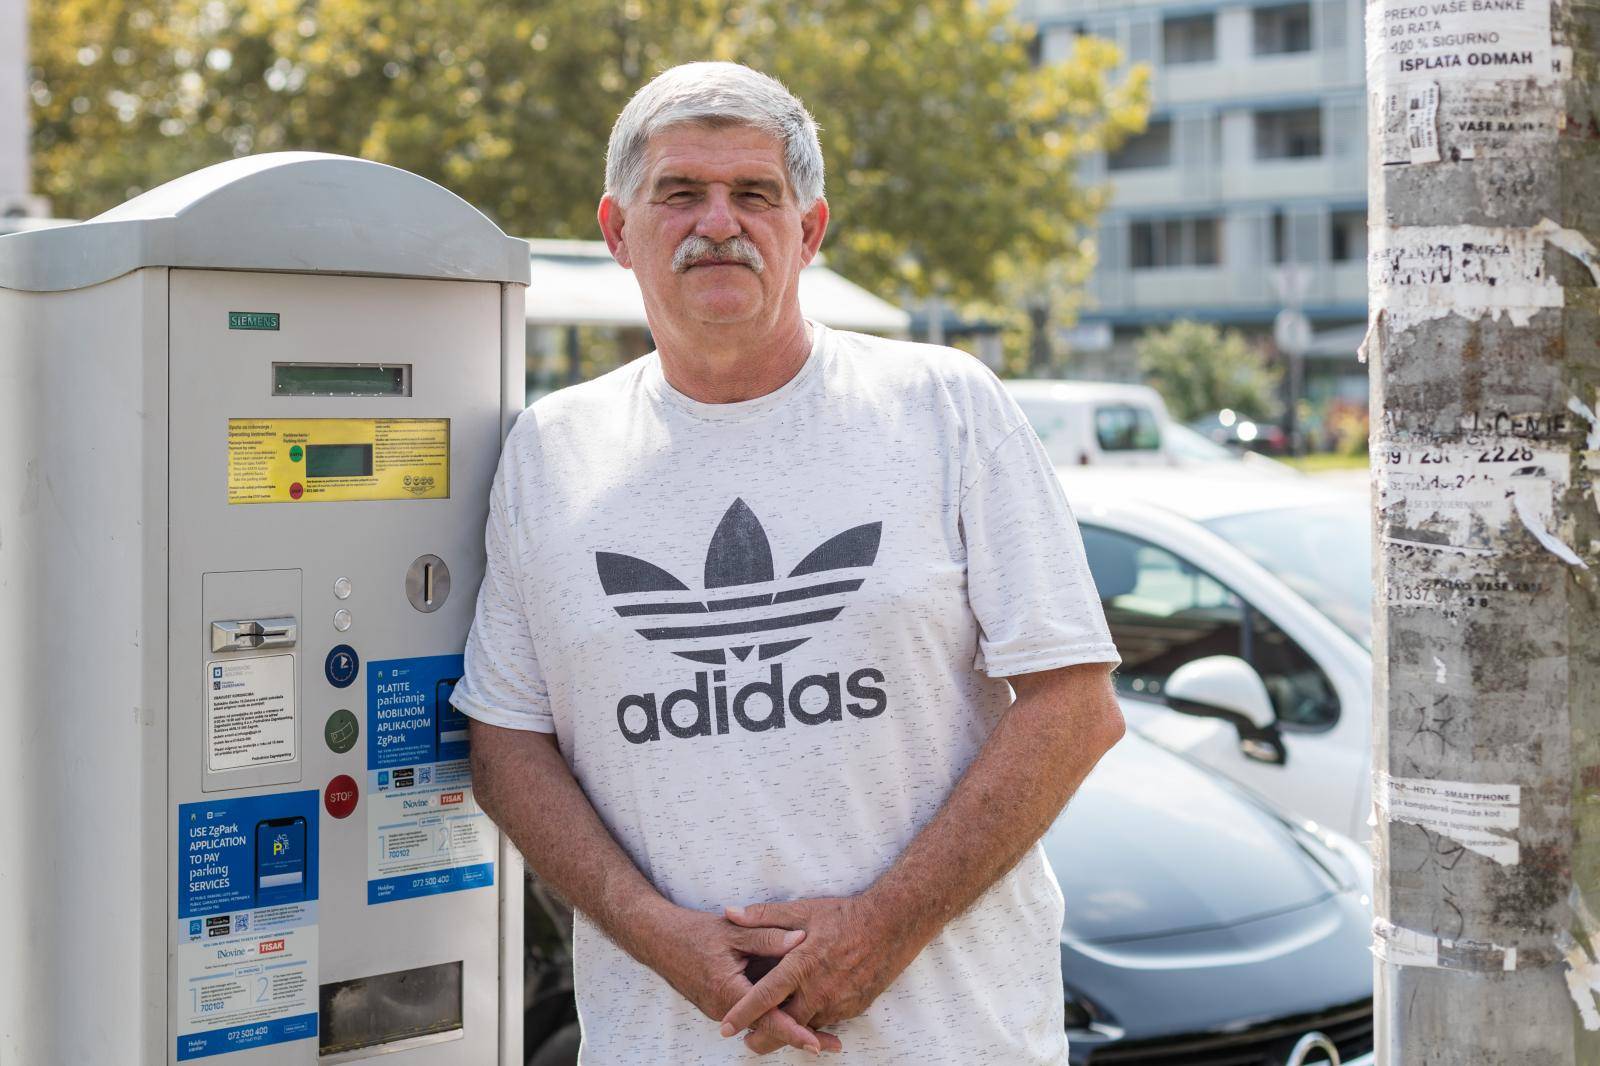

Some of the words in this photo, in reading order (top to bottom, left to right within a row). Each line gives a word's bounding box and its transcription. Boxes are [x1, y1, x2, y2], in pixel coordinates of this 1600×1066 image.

[1384, 5, 1428, 20] PREKO
[1472, 0, 1526, 11] BANKE
[1390, 24, 1404, 36] 60
[1408, 21, 1441, 33] RATA
[1433, 32, 1499, 47] SIGURNO
[1400, 54, 1462, 72] ISPLATA
[1468, 51, 1533, 66] ODMAH
[231, 315, 278, 328] SIEMENS
[377, 682, 410, 693] PLATITE
[377, 691, 425, 709] parkiranje
[616, 663, 887, 745] adidas
[377, 706, 425, 719] MOBILNOM
[377, 718, 431, 732] APLIKACIJOM
[377, 734, 406, 747] ZgPark
[330, 791, 353, 804] STOP
[442, 794, 462, 803] TISAK
[1444, 790, 1511, 801] SMARTPHONE
[190, 826, 207, 838] USE
[208, 823, 238, 837] ZgPark
[190, 835, 247, 851] APPLICATION
[190, 854, 202, 864] TO
[204, 852, 220, 863] PAY
[190, 864, 228, 881] parking
[190, 878, 230, 892] SERVICES
[425, 877, 437, 885] 500
[260, 942, 283, 953] TISAK
[200, 1001, 224, 1012] 700102
[227, 1031, 240, 1041] 072
[241, 1029, 254, 1038] 500
[255, 1026, 268, 1036] 400
